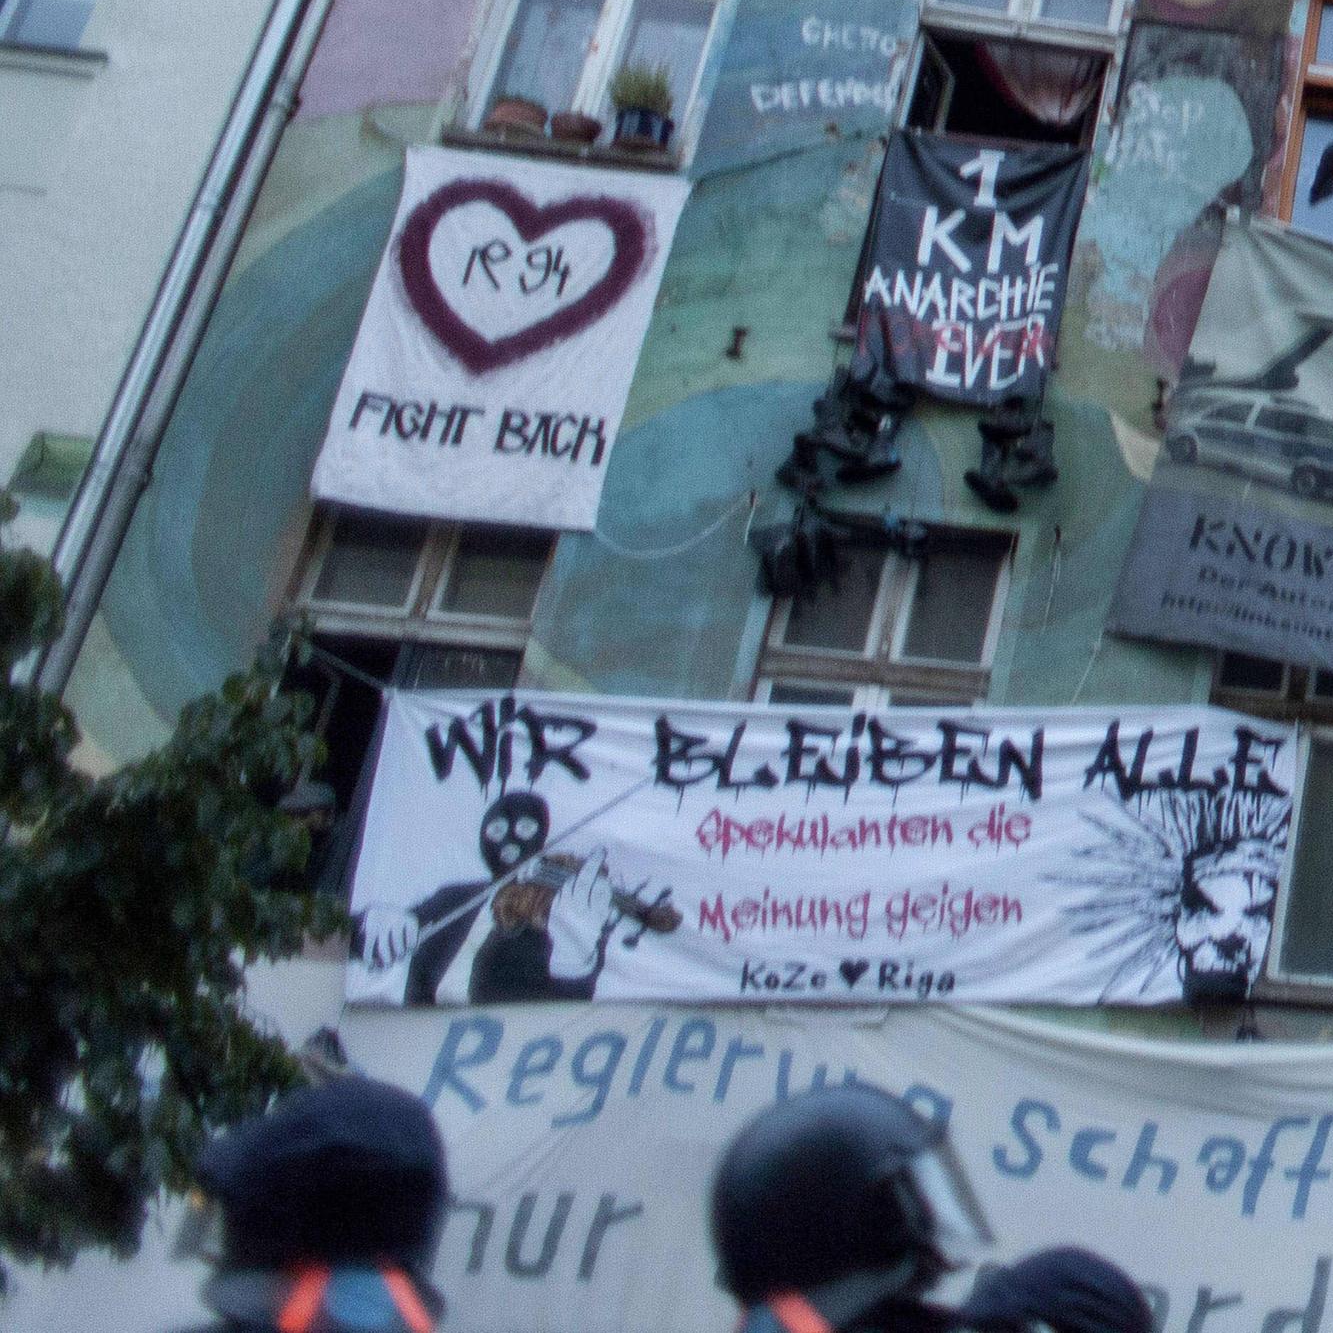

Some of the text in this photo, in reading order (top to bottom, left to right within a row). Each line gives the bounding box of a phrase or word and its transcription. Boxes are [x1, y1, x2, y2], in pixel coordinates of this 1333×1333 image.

[960, 149, 1005, 208] 1
[864, 262, 1059, 321] ANARCHIE
[347, 392, 487, 449] FIGHT
[1082, 716, 1293, 802] ALLE
[697, 801, 1032, 859] Spekulanten die
[699, 881, 1023, 944] Meinung geigen
